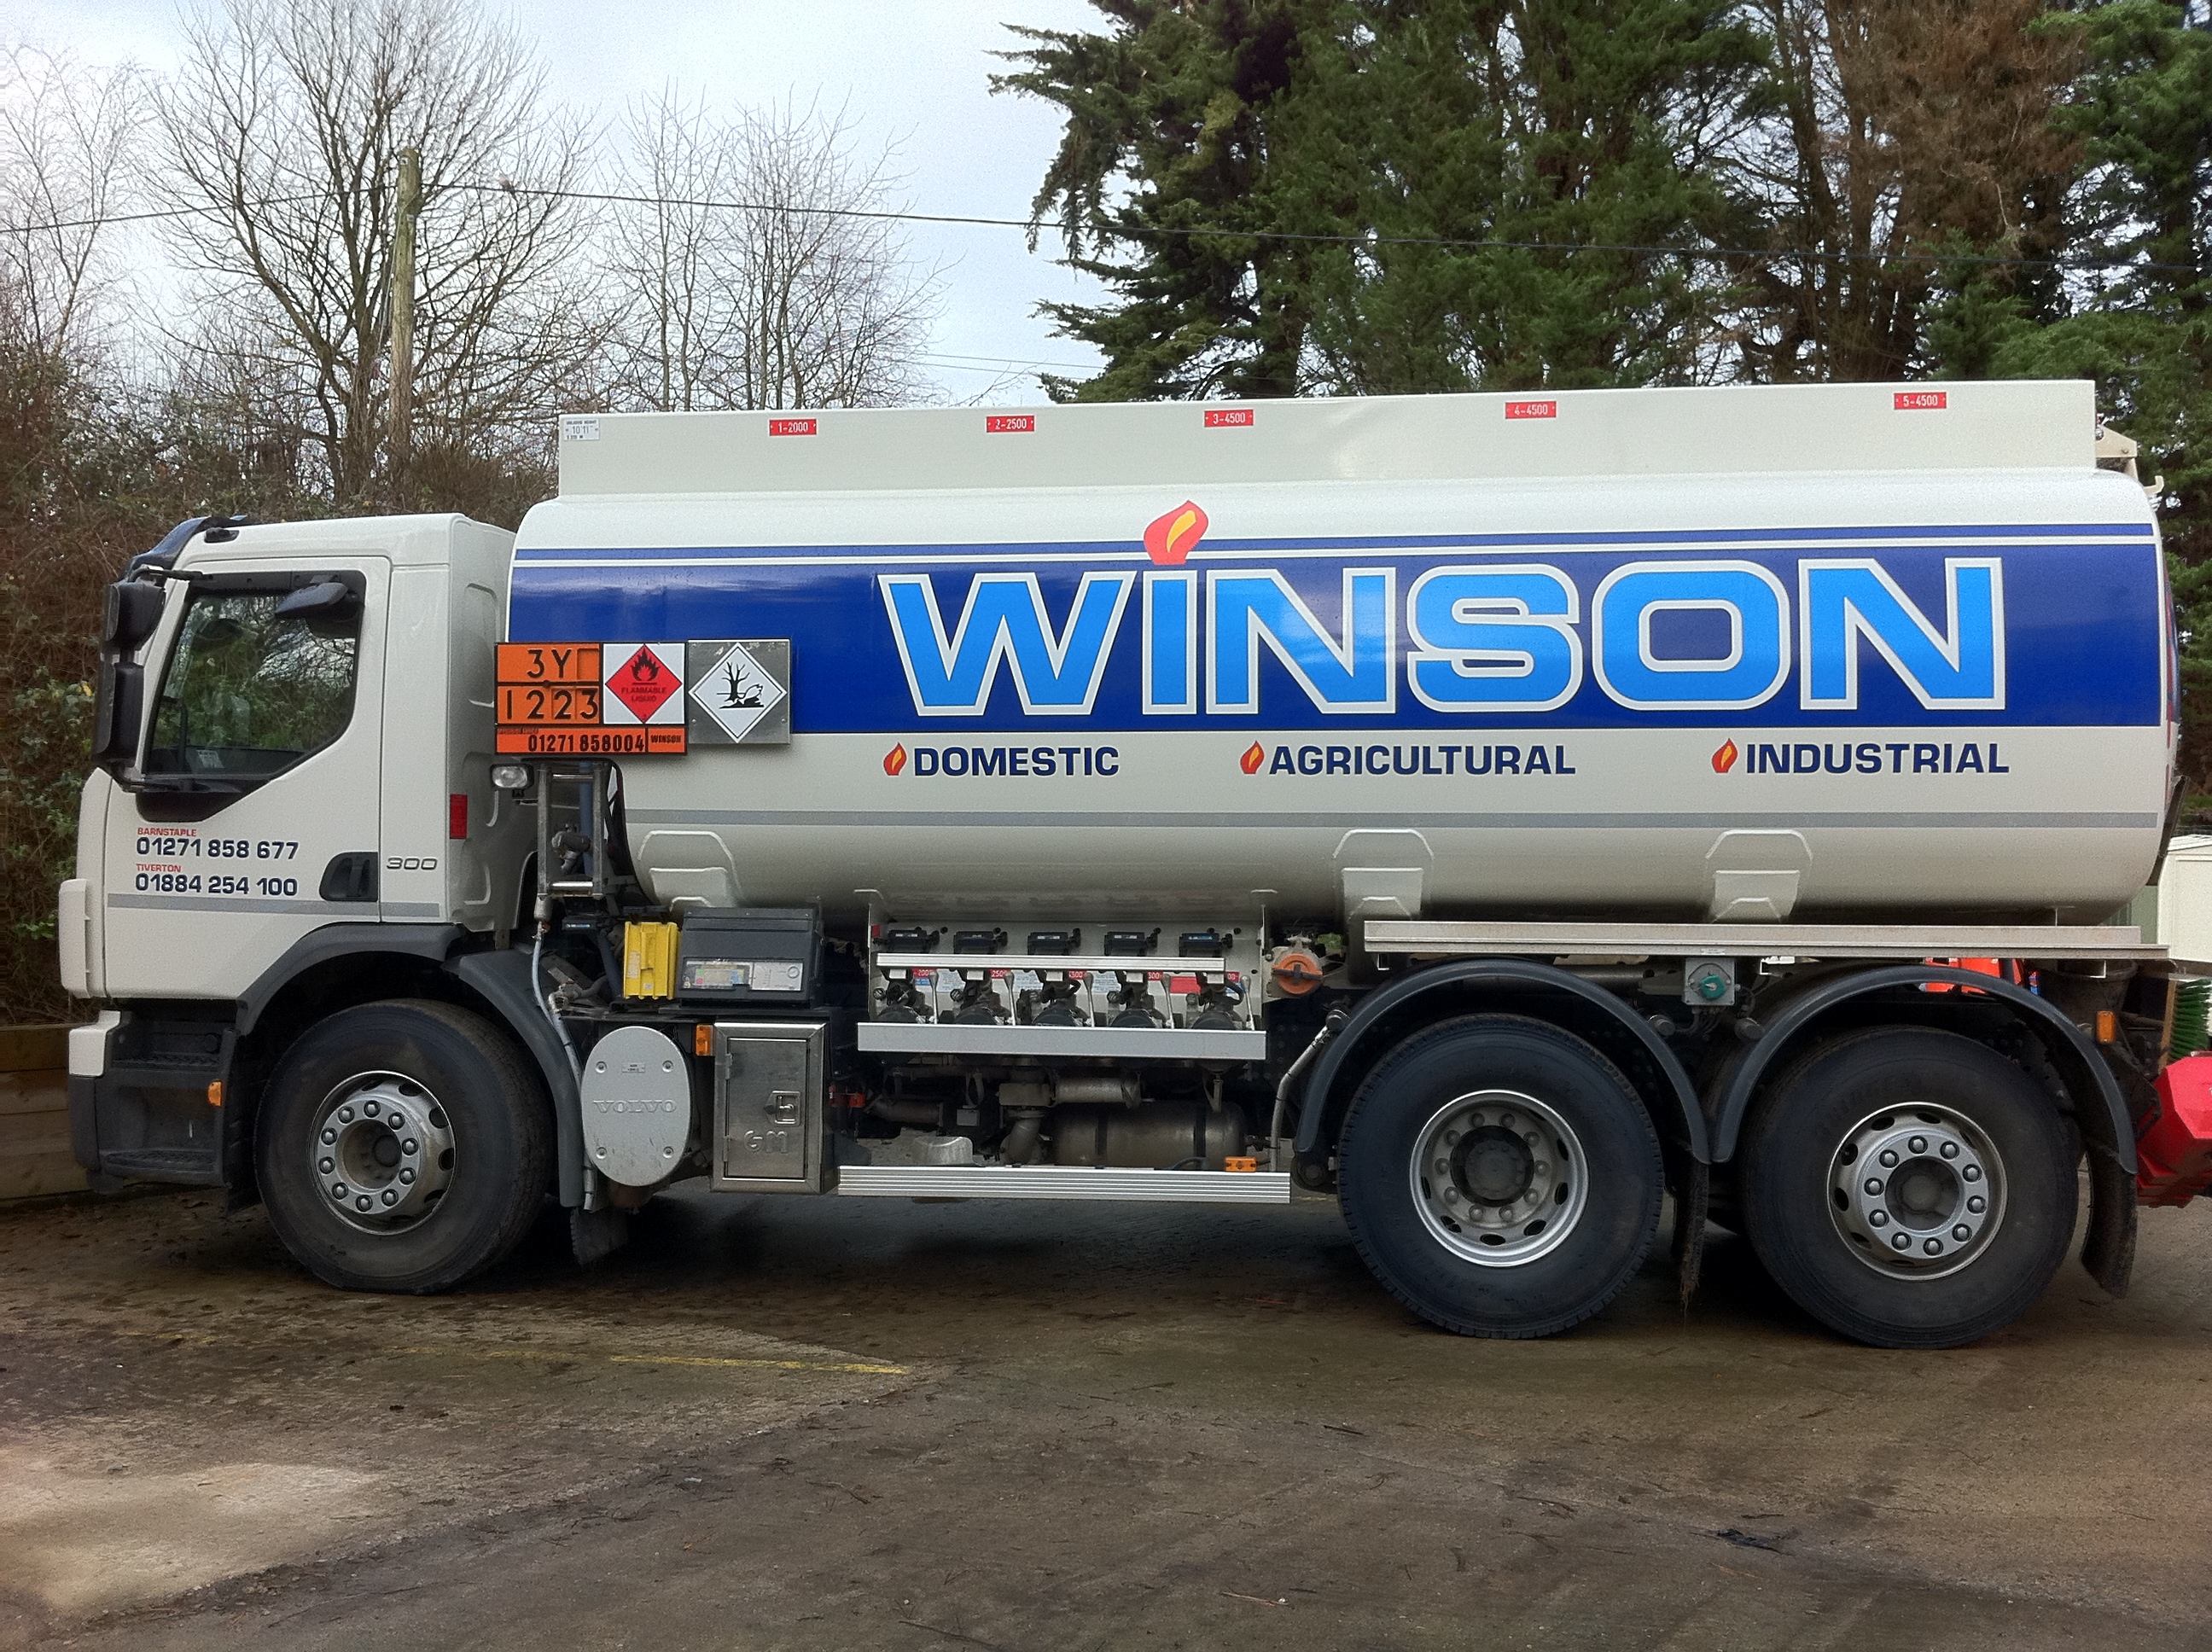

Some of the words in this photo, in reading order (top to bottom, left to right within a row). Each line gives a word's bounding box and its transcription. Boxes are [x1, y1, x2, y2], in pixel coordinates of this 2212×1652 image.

[1903, 394, 1938, 407] 5-4500
[1514, 404, 1548, 416] 4-4500
[995, 418, 1027, 430] 2-2500
[1213, 413, 1246, 424] 3-4500
[777, 422, 808, 433] 1-2000
[877, 557, 2005, 716] WINSON
[527, 649, 572, 678] 3Y
[507, 689, 598, 719] 1223
[528, 735, 575, 752] 01271
[579, 735, 644, 752] 858004
[650, 735, 681, 743] WINSON
[914, 746, 1120, 777] DOMESTIC
[1269, 745, 1576, 775] AGRICULTURAL
[1746, 742, 2010, 773] INDUSTRIAL
[137, 828, 197, 837] BARNSTAPLE
[137, 836, 201, 857] 01271
[207, 839, 249, 858] 858
[257, 841, 300, 860] 677
[137, 864, 182, 873] TIVERTON
[387, 856, 438, 870] 300
[136, 873, 201, 893] 01884
[208, 875, 249, 895] 254
[256, 877, 298, 897] 100
[593, 1099, 677, 1114] VOLVO
